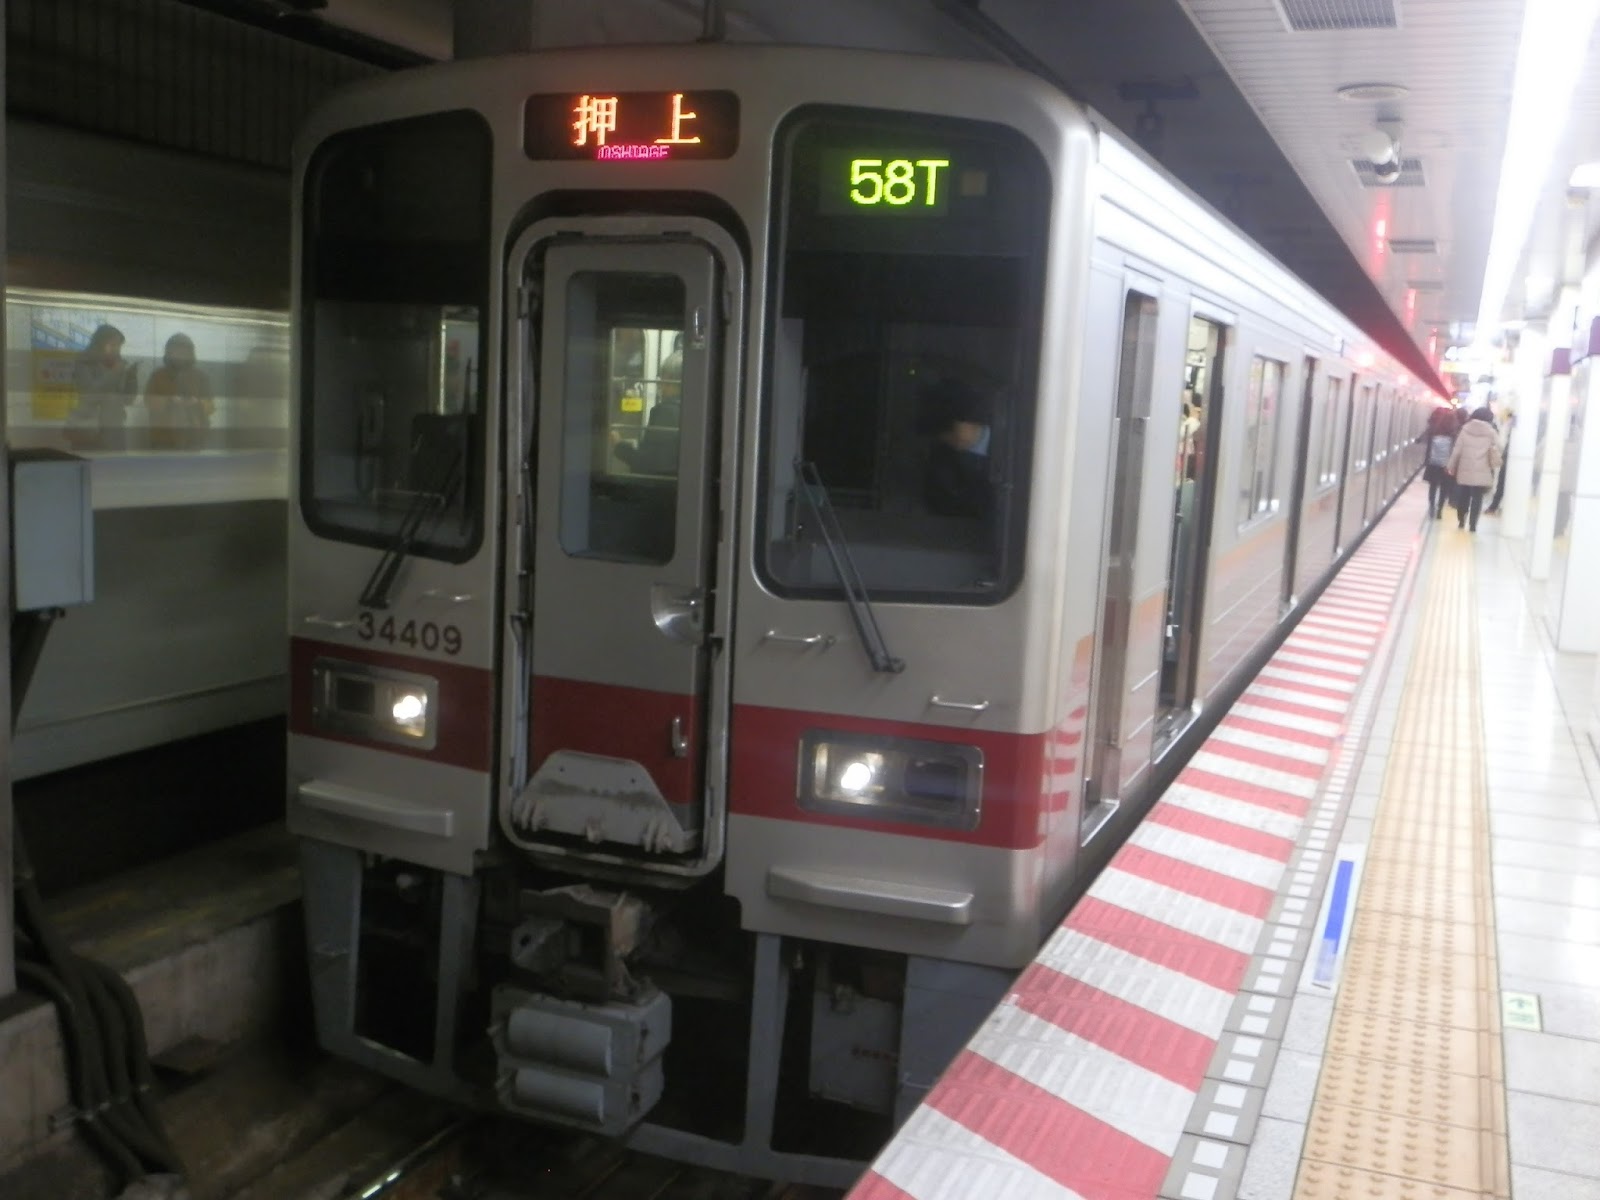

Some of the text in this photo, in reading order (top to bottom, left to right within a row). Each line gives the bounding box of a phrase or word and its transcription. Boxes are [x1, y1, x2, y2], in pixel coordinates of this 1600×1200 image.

[573, 94, 700, 145] 押上
[850, 159, 950, 205] 58T
[357, 611, 462, 656] 34409
